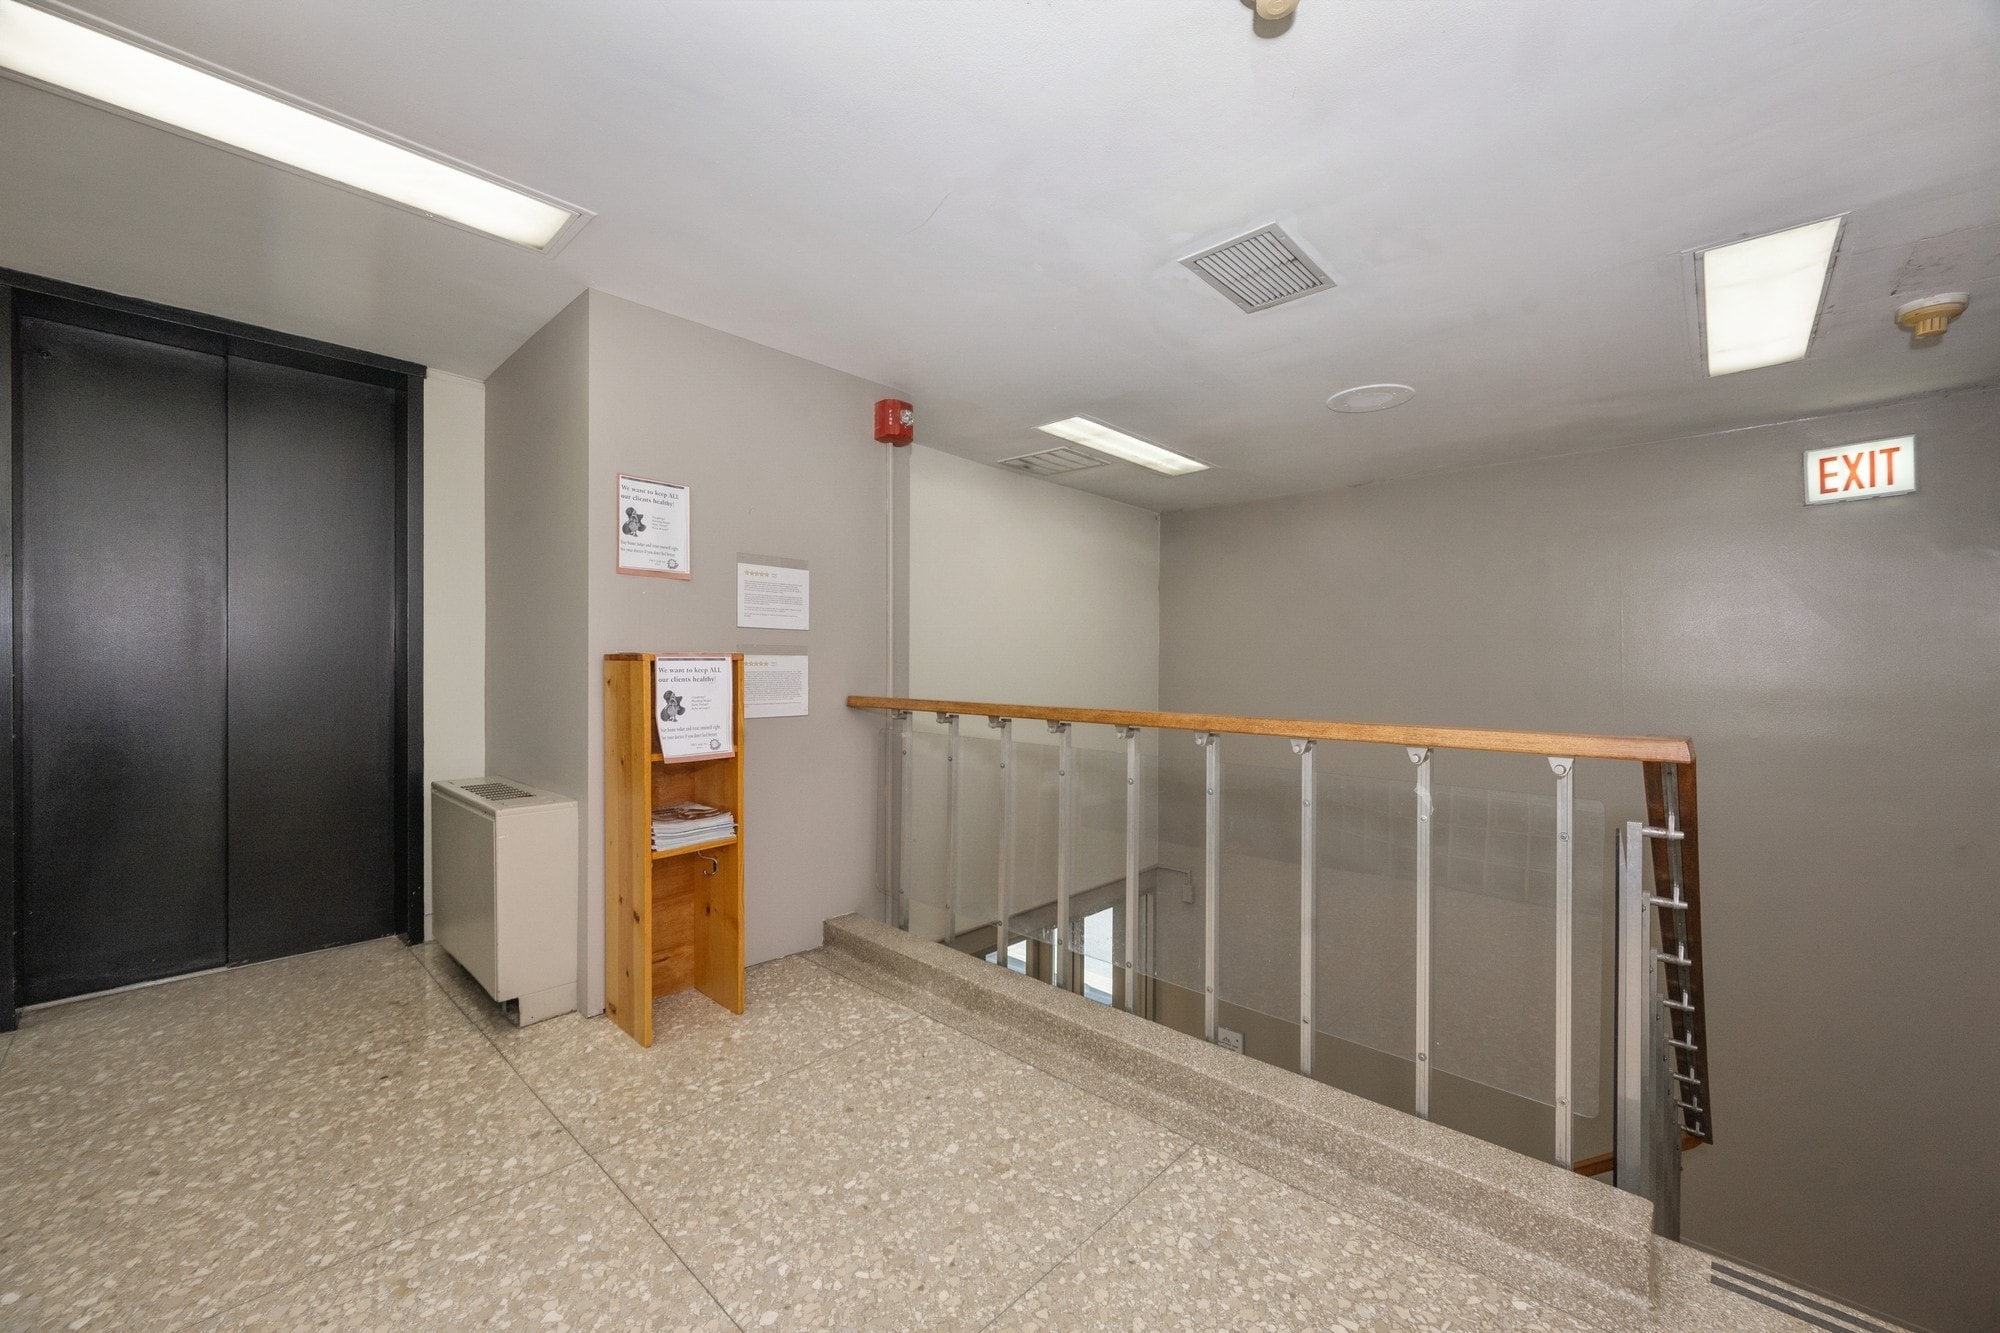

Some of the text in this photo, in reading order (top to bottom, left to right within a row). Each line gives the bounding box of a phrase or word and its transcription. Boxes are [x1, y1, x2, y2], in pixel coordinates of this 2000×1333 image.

[1819, 446, 1900, 494] EXIT
[655, 490, 667, 499] keep
[632, 495, 652, 503] clients
[653, 498, 674, 508] healthy!
[692, 676, 717, 684] healthy!
